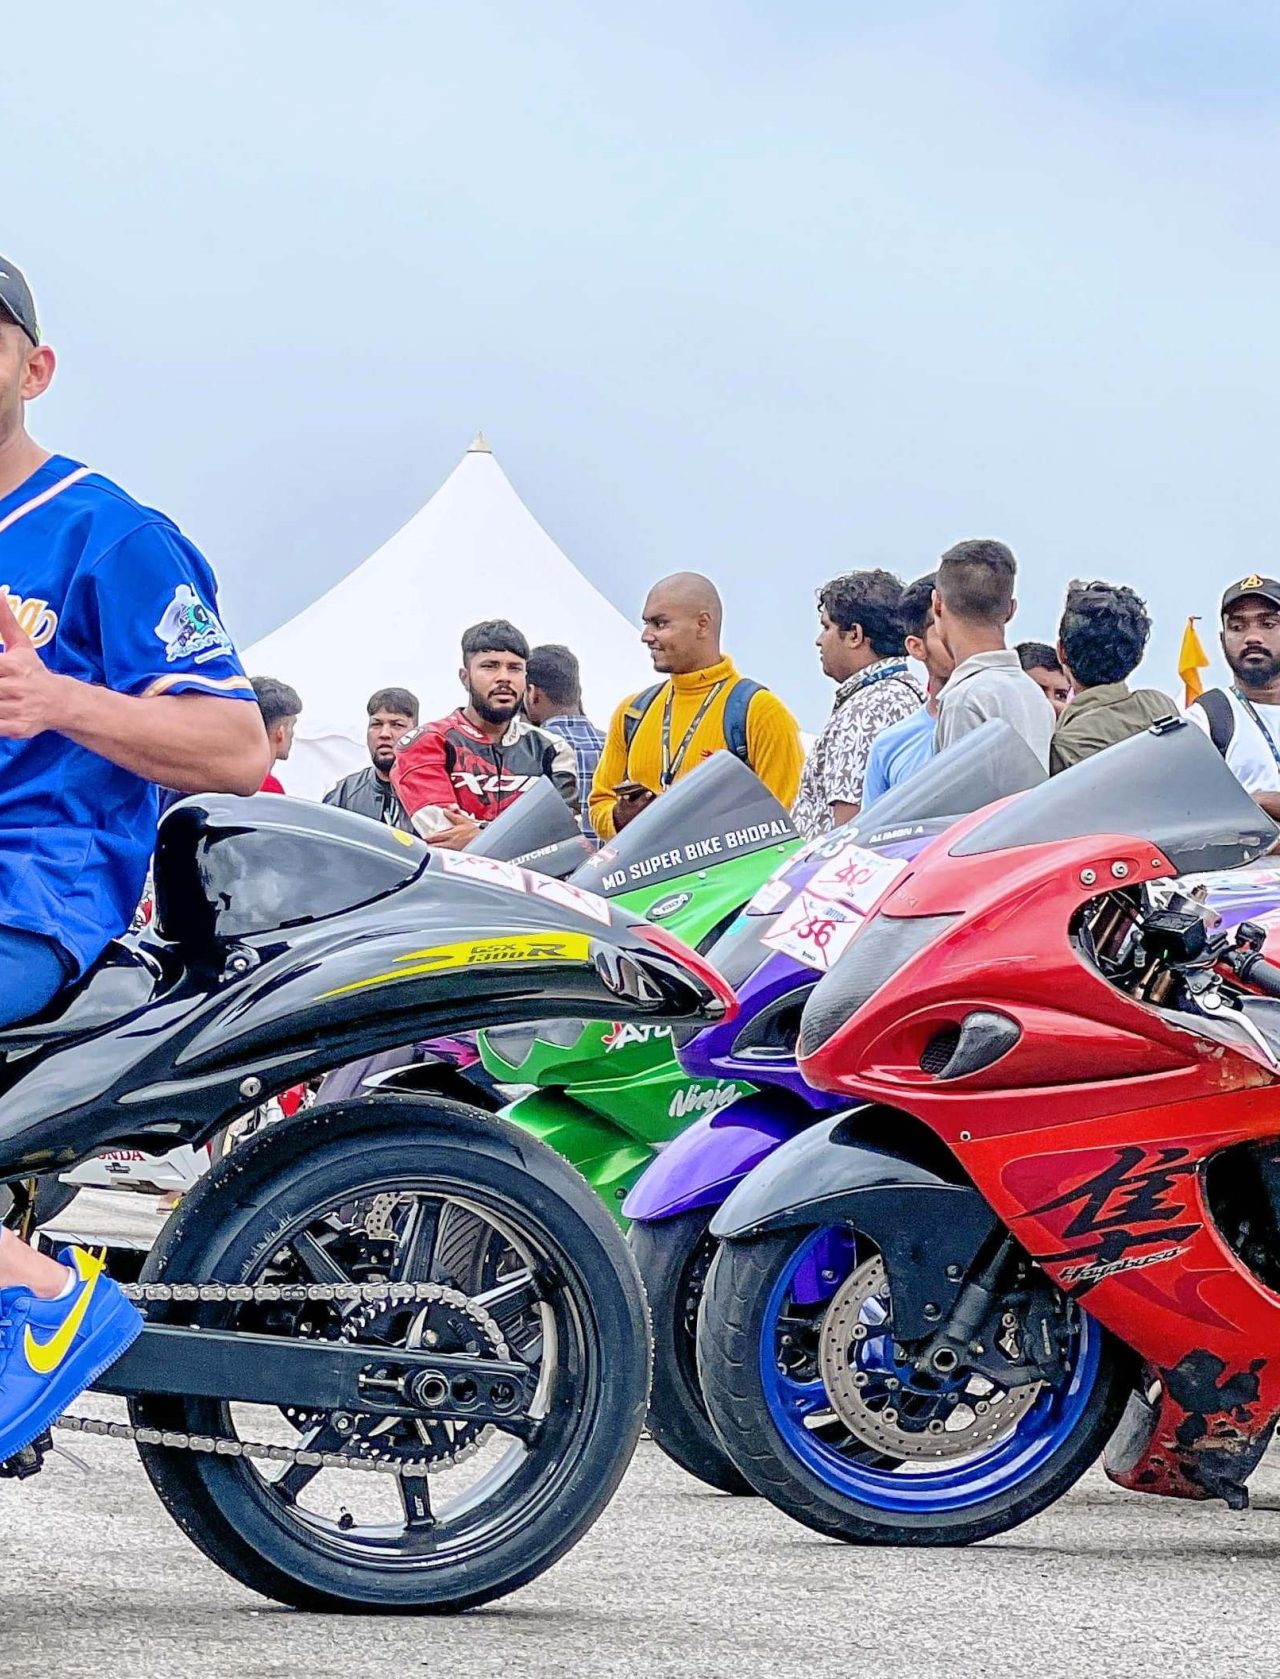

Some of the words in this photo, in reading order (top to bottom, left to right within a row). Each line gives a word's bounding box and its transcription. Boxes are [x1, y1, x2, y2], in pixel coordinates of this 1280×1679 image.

[508, 843, 558, 867] LUTCHES
[601, 871, 627, 891] MD
[629, 849, 683, 880] SUPER
[685, 836, 722, 861] BIKE
[725, 819, 791, 848] BHOPAL
[525, 943, 566, 957] R
[669, 1079, 743, 1118] Ninja
